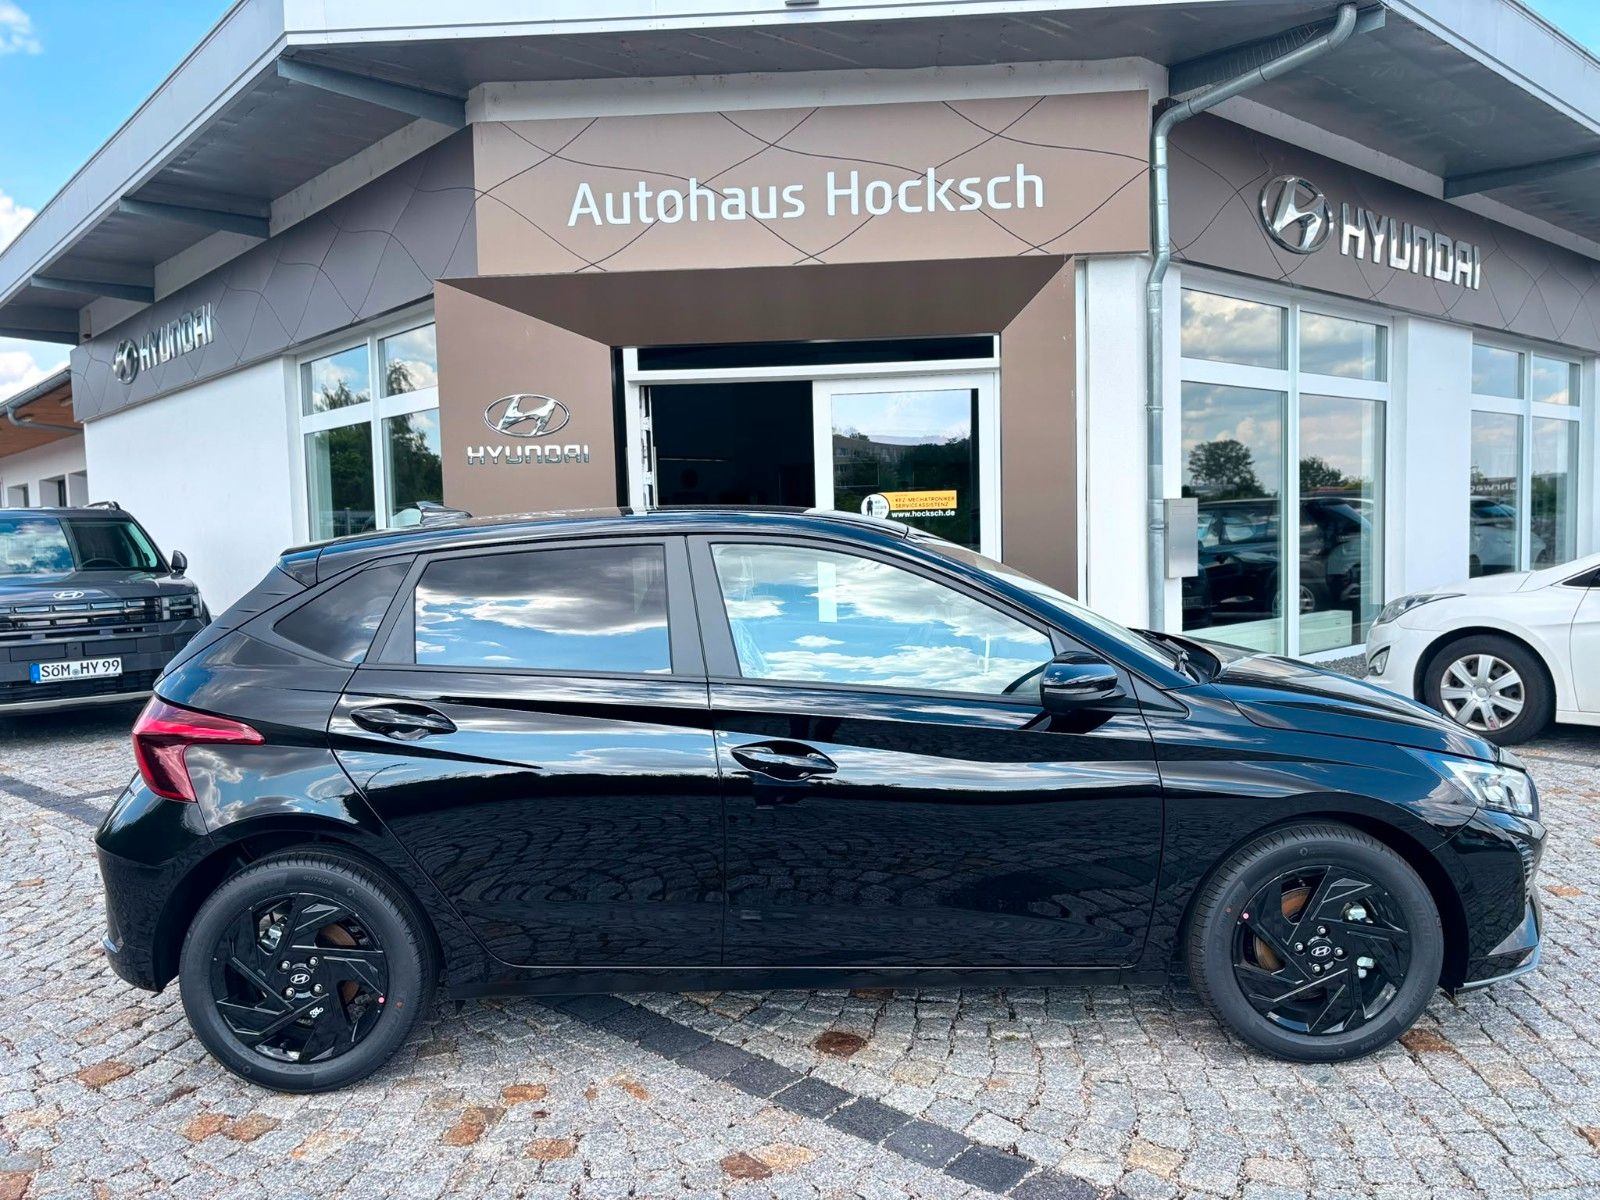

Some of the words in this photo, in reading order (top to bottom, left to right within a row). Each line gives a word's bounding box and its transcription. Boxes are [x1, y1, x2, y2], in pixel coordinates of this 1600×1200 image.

[567, 177, 805, 227] Autohaus
[826, 163, 1044, 217] Hocksch
[1340, 202, 1481, 290] HYUNDAI
[139, 302, 213, 371] HYUNDAI
[467, 444, 589, 465] HYUNDAI
[80, 661, 99, 674] HY
[102, 659, 120, 673] 99
